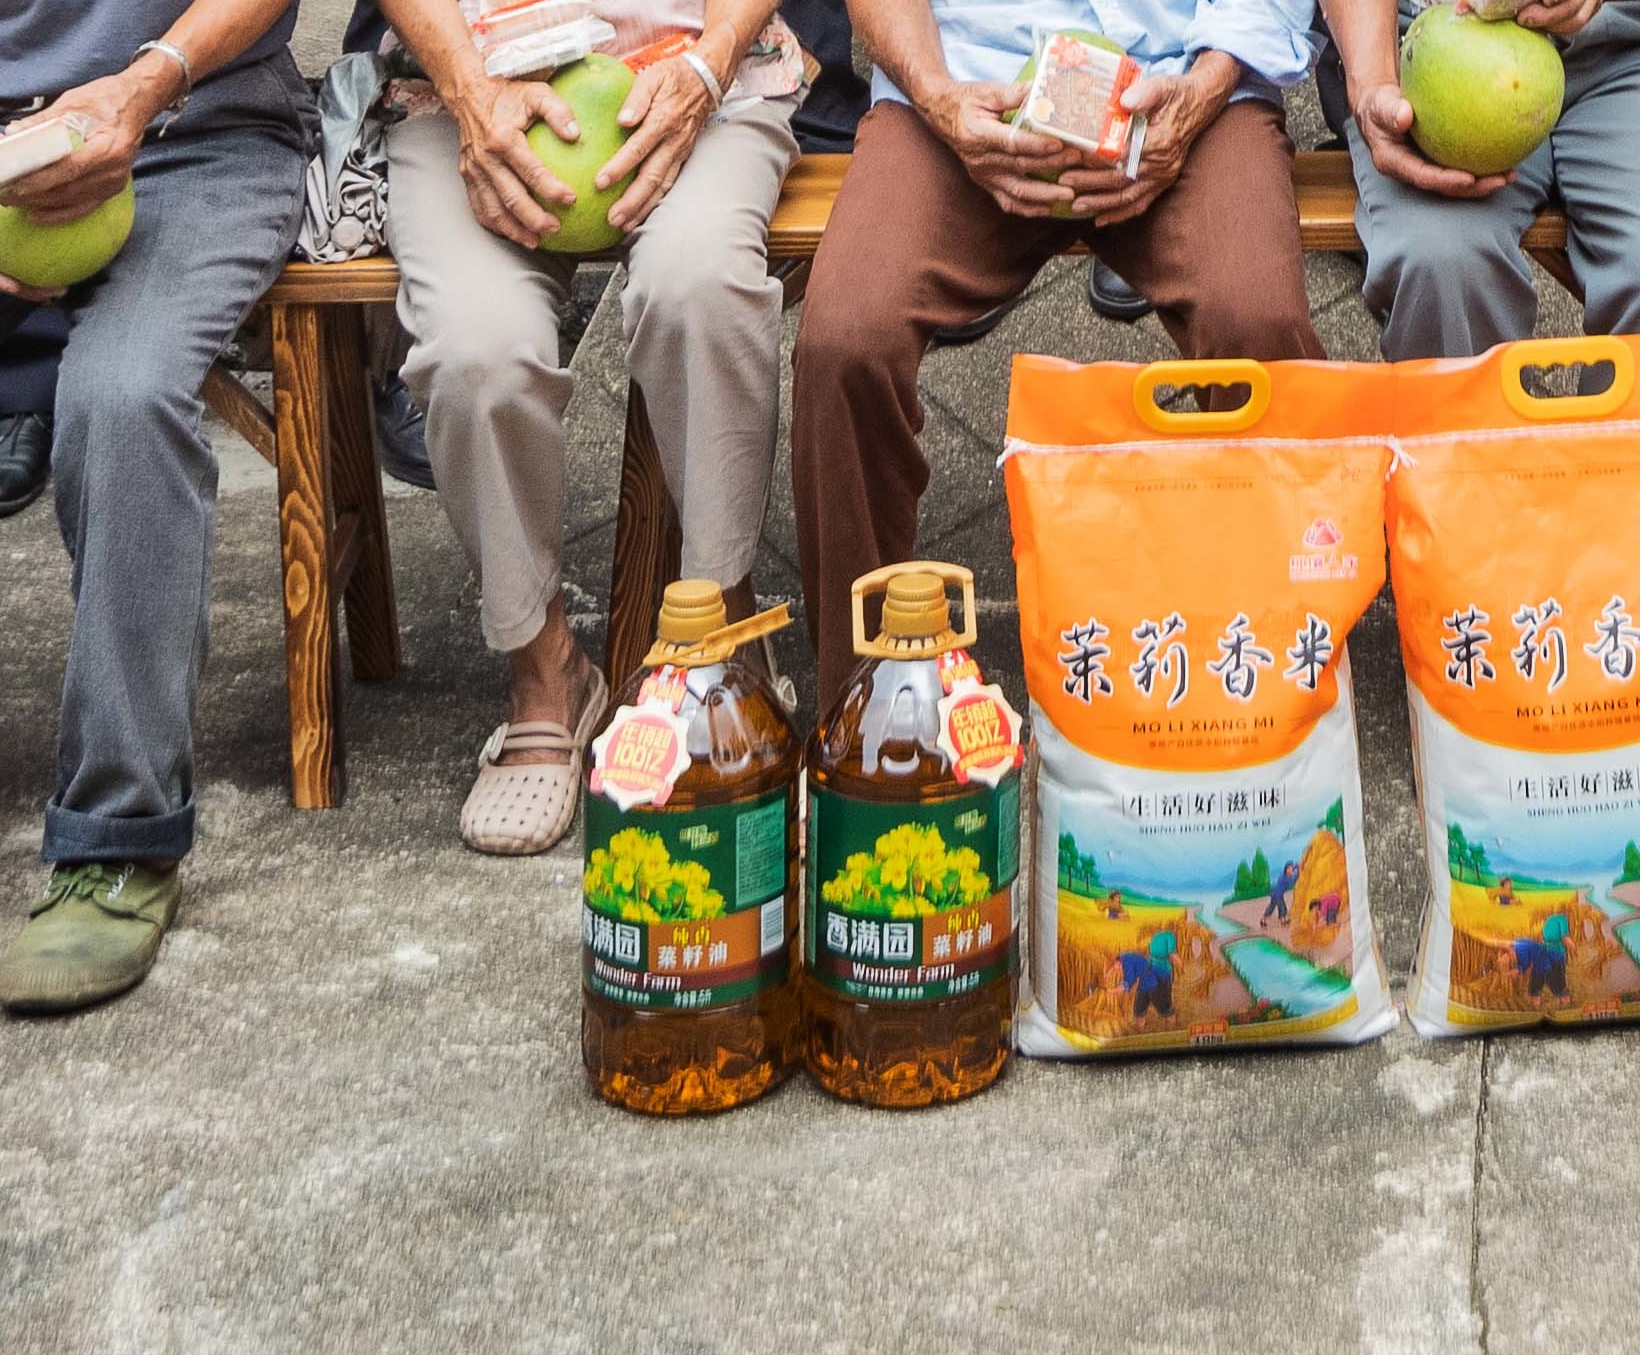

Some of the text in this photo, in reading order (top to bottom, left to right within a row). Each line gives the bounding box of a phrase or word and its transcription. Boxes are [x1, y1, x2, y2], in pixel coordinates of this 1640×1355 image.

[1057, 611, 1334, 710] 茉莉香米
[1516, 705, 1545, 719] MO
[1551, 703, 1570, 717] LI
[1573, 698, 1629, 713] XIANG
[1132, 717, 1275, 735] MO LI XIANG MI
[1128, 786, 1280, 817] 生活好滋味
[826, 911, 914, 962] 香满园
[593, 957, 638, 986] Wonder
[643, 971, 682, 990] Farm
[852, 961, 955, 983] Wonder Farm
